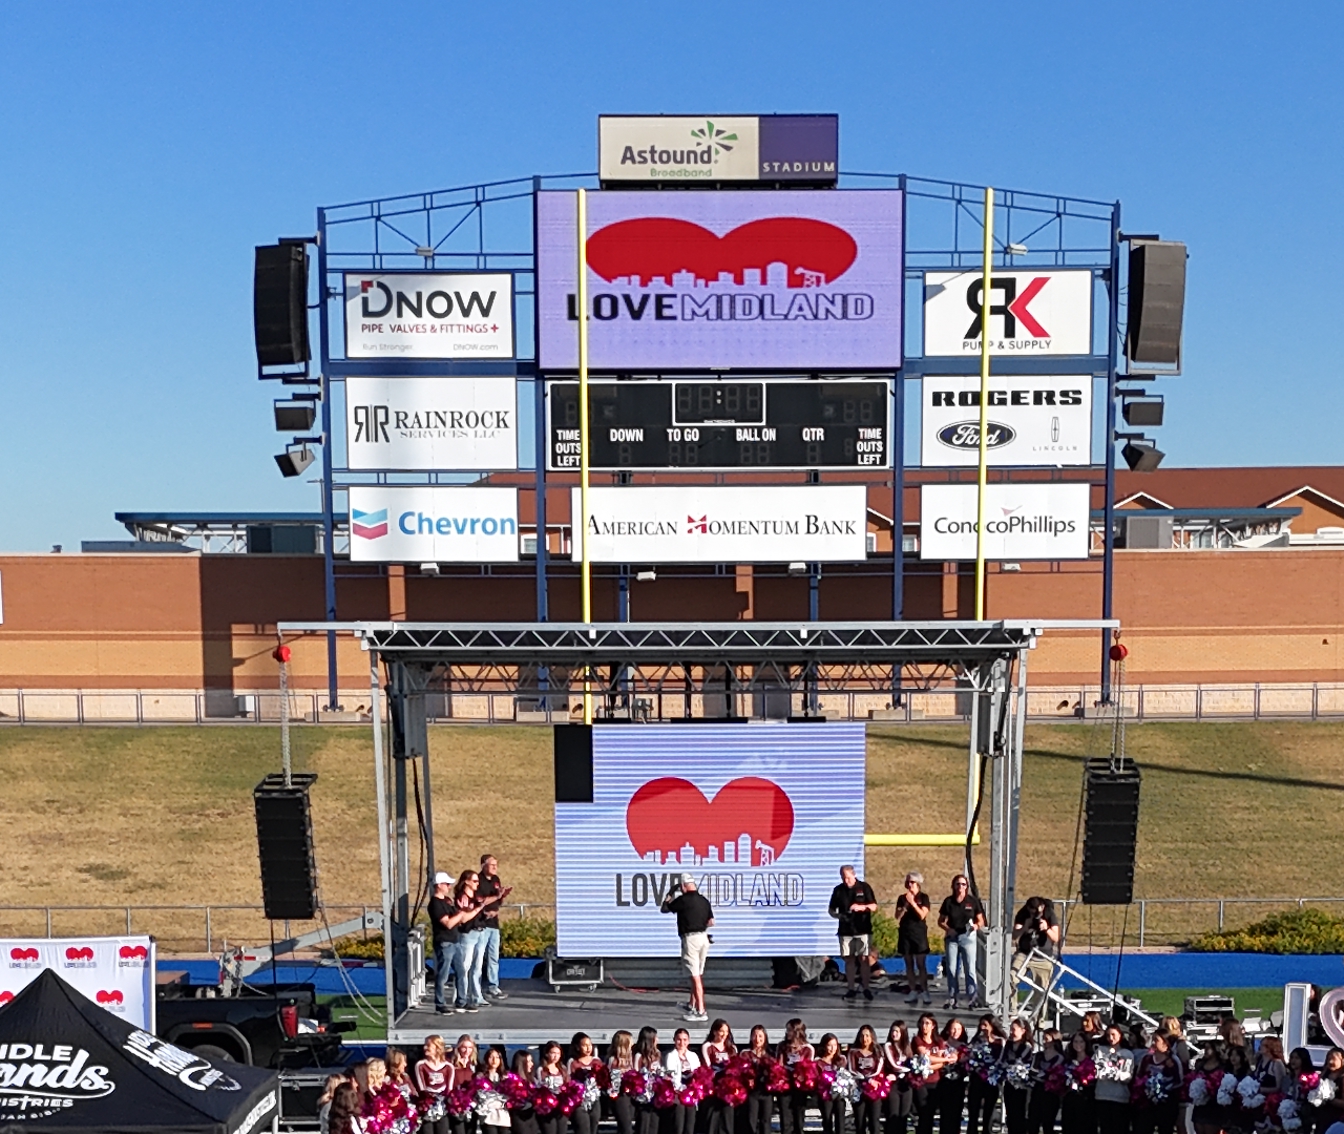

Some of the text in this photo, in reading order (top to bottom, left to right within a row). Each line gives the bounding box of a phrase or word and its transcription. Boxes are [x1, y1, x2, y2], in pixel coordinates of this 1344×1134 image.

[621, 145, 712, 165] Astound
[650, 168, 712, 178] Broadband
[763, 162, 835, 173] STADIUM
[361, 280, 497, 319] DNOW
[361, 324, 384, 333] PIPE
[389, 324, 427, 333] VALVES
[430, 324, 437, 333] &
[998, 342, 1005, 350] &
[1009, 340, 1052, 349] SUPPLY
[932, 390, 1082, 407] ROGERS
[394, 411, 510, 429] RAINROCK
[400, 430, 500, 438] SERVICES LLC
[556, 429, 581, 441] TIME
[609, 427, 825, 442] DOWN TO GO BALL ON QTR
[858, 428, 883, 440] TIME
[555, 442, 581, 455] OUTS
[857, 441, 883, 453] OUTS
[557, 455, 581, 467] LEFT
[858, 453, 881, 466] LEFT
[398, 511, 516, 535] Chevron
[588, 514, 678, 535] AMERICAN
[805, 514, 857, 535] BANK
